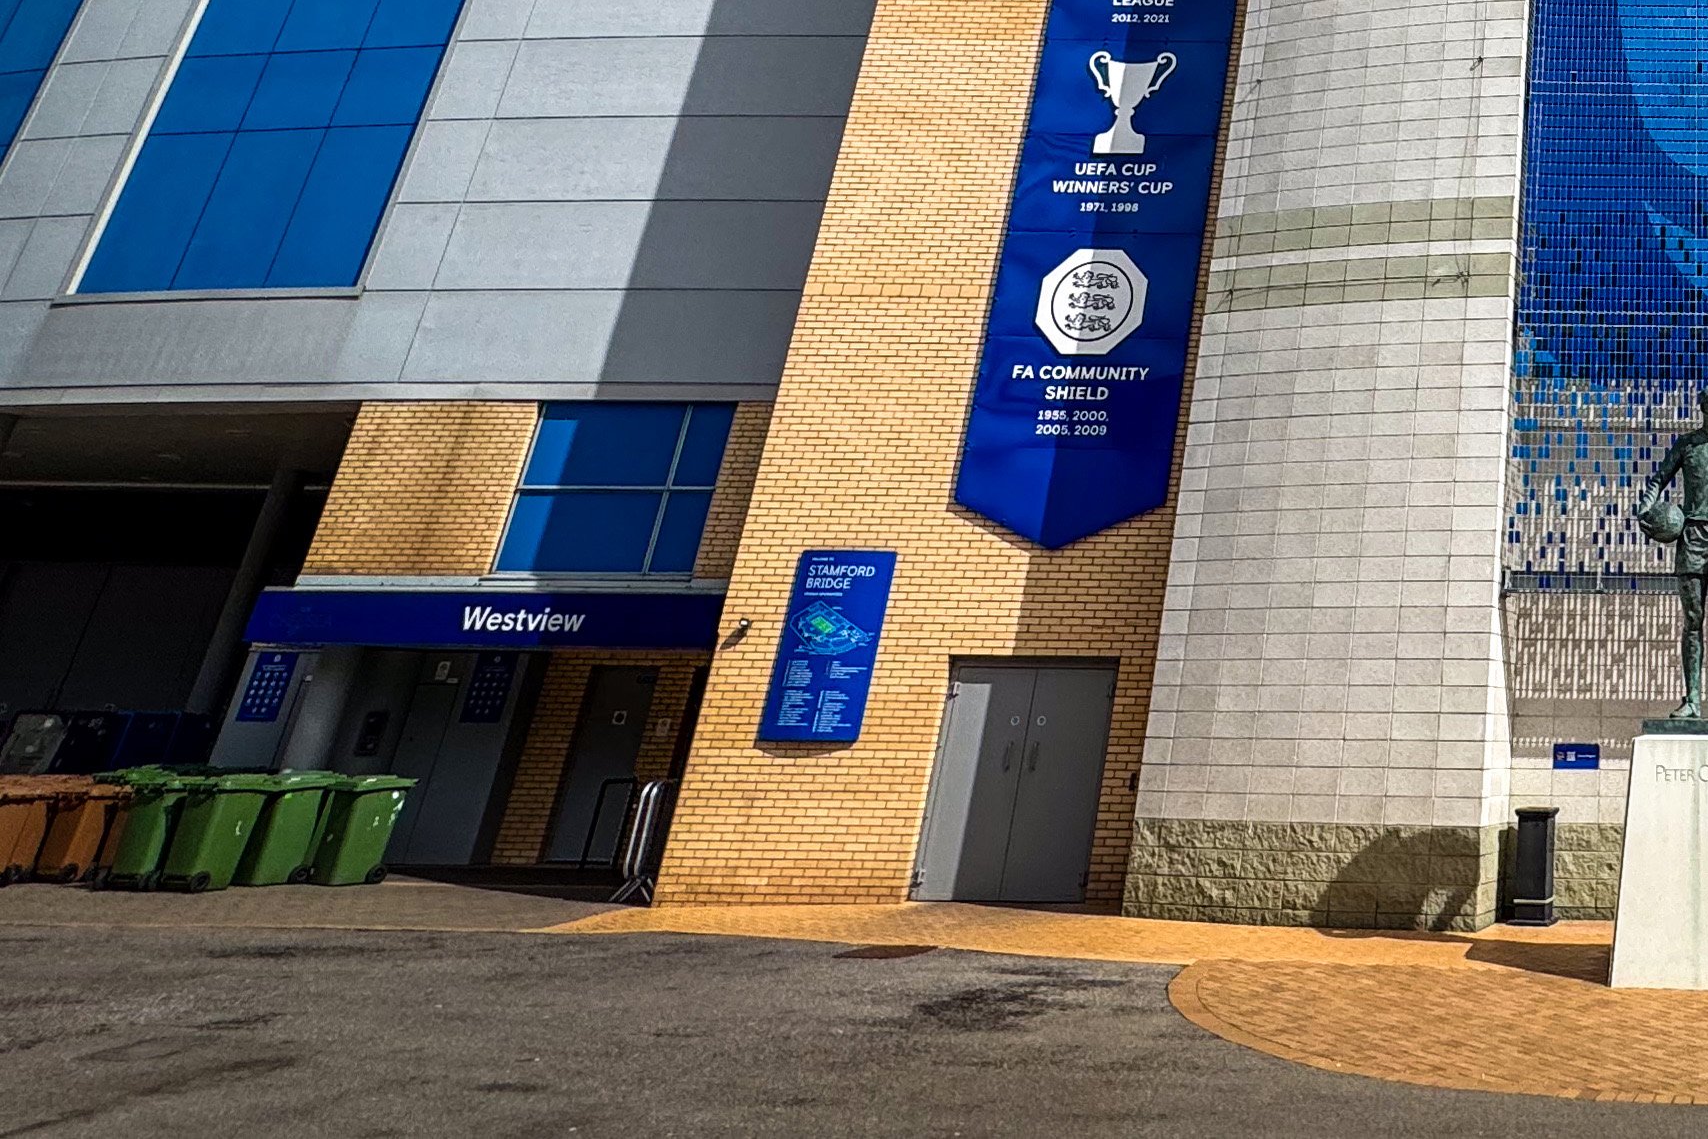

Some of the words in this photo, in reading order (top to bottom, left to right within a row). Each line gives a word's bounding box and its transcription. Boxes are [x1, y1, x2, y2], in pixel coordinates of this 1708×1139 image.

[1112, 14, 1141, 23] 2012,
[1144, 14, 1170, 23] 2021
[1075, 163, 1117, 176] UEFA
[1122, 164, 1157, 176] CUP
[1052, 180, 1135, 194] WINNERS'
[1138, 181, 1173, 194] CUP
[1080, 202, 1109, 213] 1971,
[1012, 365, 1035, 380] FA
[1040, 365, 1150, 381] COMMUNITY
[1045, 386, 1109, 401] SHIELD
[1072, 411, 1109, 422] 2000,
[1035, 425, 1071, 436] 2005,
[808, 565, 876, 577] STAMFORD
[806, 578, 852, 589] BRIDGE
[463, 606, 586, 632] Westview
